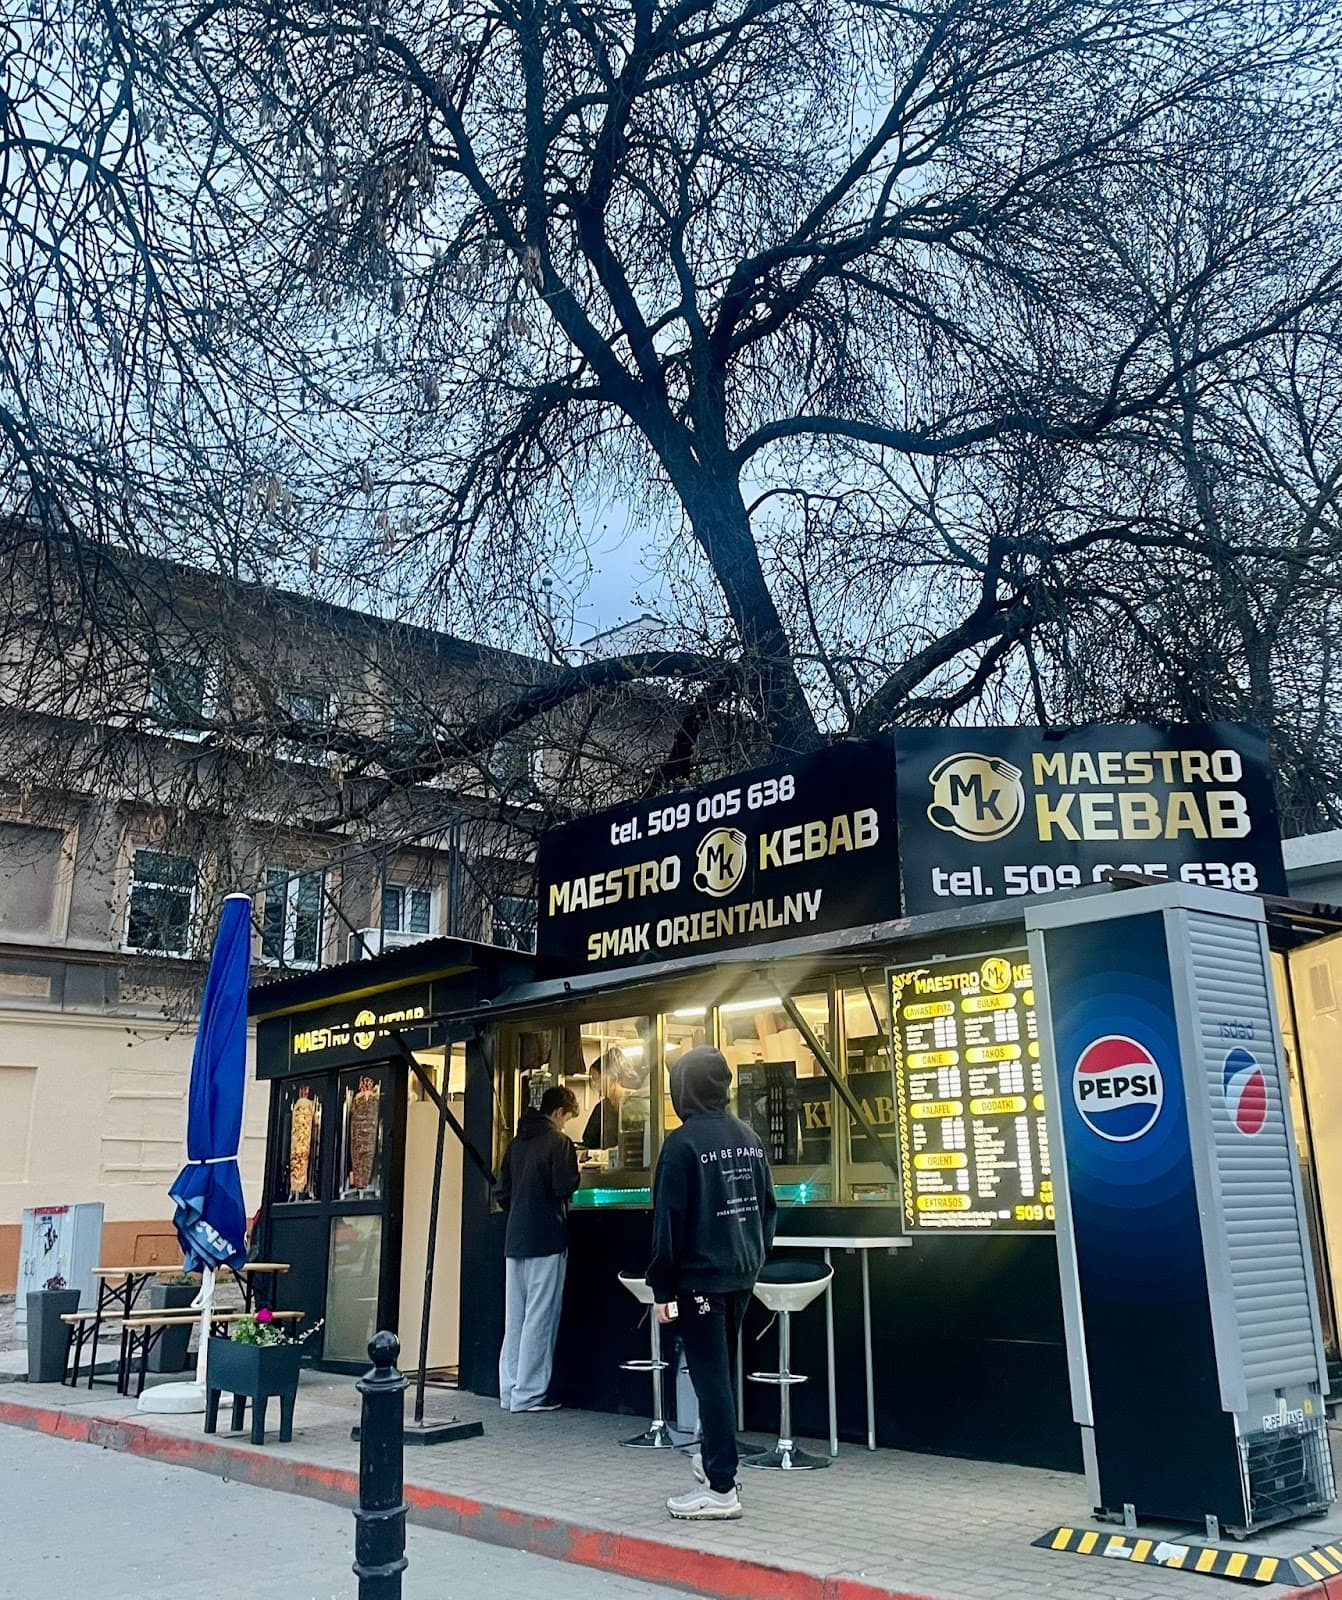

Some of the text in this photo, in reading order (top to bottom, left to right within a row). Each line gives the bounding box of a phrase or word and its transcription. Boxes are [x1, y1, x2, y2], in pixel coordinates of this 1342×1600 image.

[1031, 749, 1243, 786] MAESTRO
[610, 774, 795, 847] tel. 509 005 638
[1034, 790, 1252, 842] KEBAB
[548, 855, 681, 917] MAESTRO
[759, 807, 879, 871] KEBAB
[931, 866, 993, 897] tel.
[1003, 864, 1081, 896] 509
[587, 888, 823, 961] SMAK ORIENTALNY
[914, 971, 980, 994] MAESTRO
[1078, 1074, 1158, 1101] PEPSI
[736, 1146, 763, 1159] PARIS
[927, 1155, 953, 1166] ORIENT
[1015, 1205, 1044, 1221] 509
